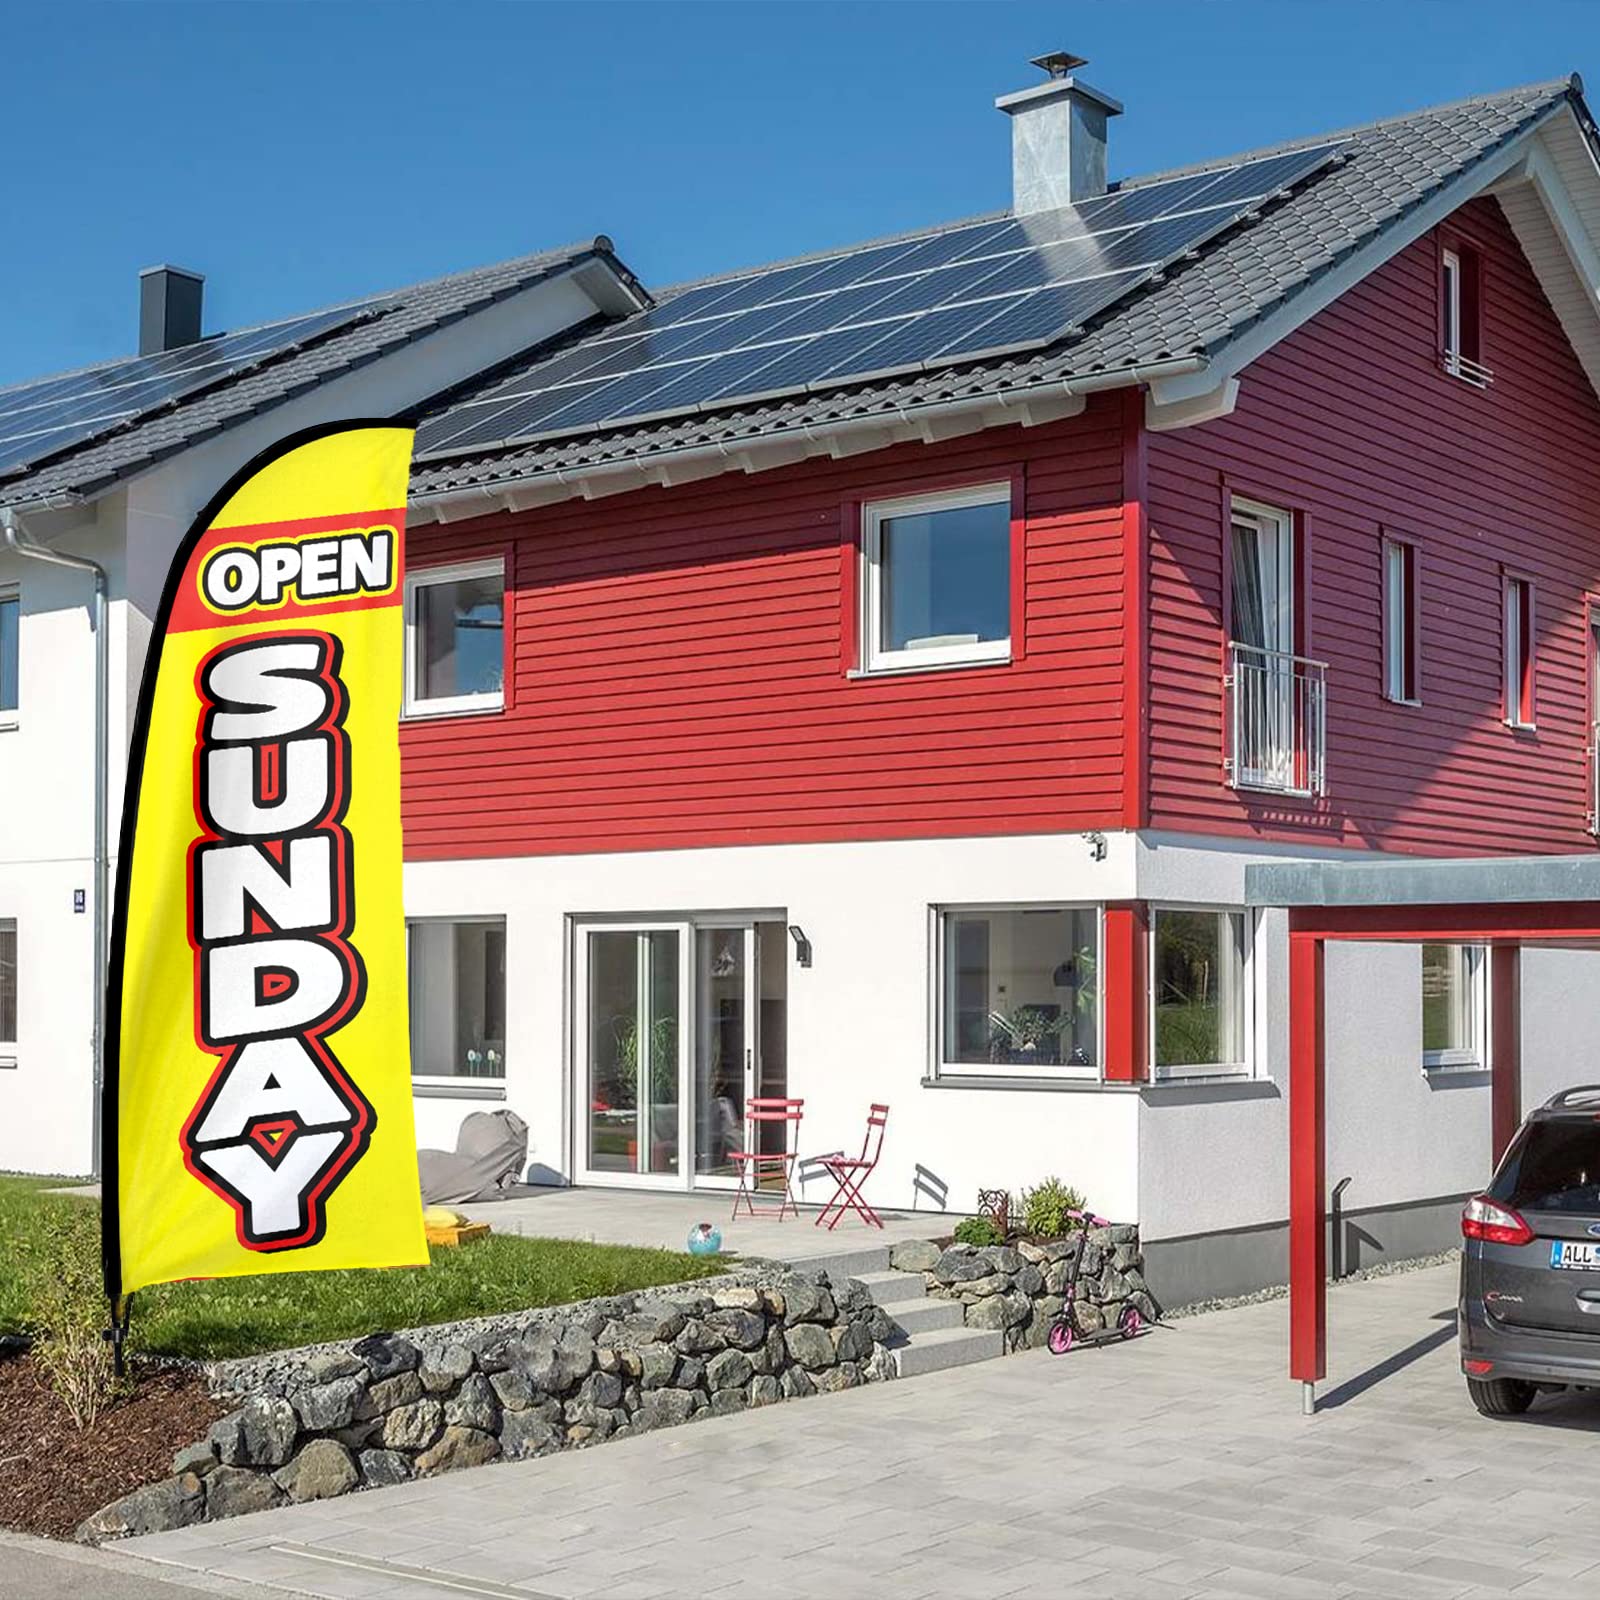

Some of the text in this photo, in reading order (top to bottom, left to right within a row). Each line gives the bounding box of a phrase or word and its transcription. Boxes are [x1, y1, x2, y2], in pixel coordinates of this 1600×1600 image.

[204, 531, 391, 610] OPEN
[187, 636, 366, 1242] SUNDAY
[1563, 1245, 1592, 1263] ALL
